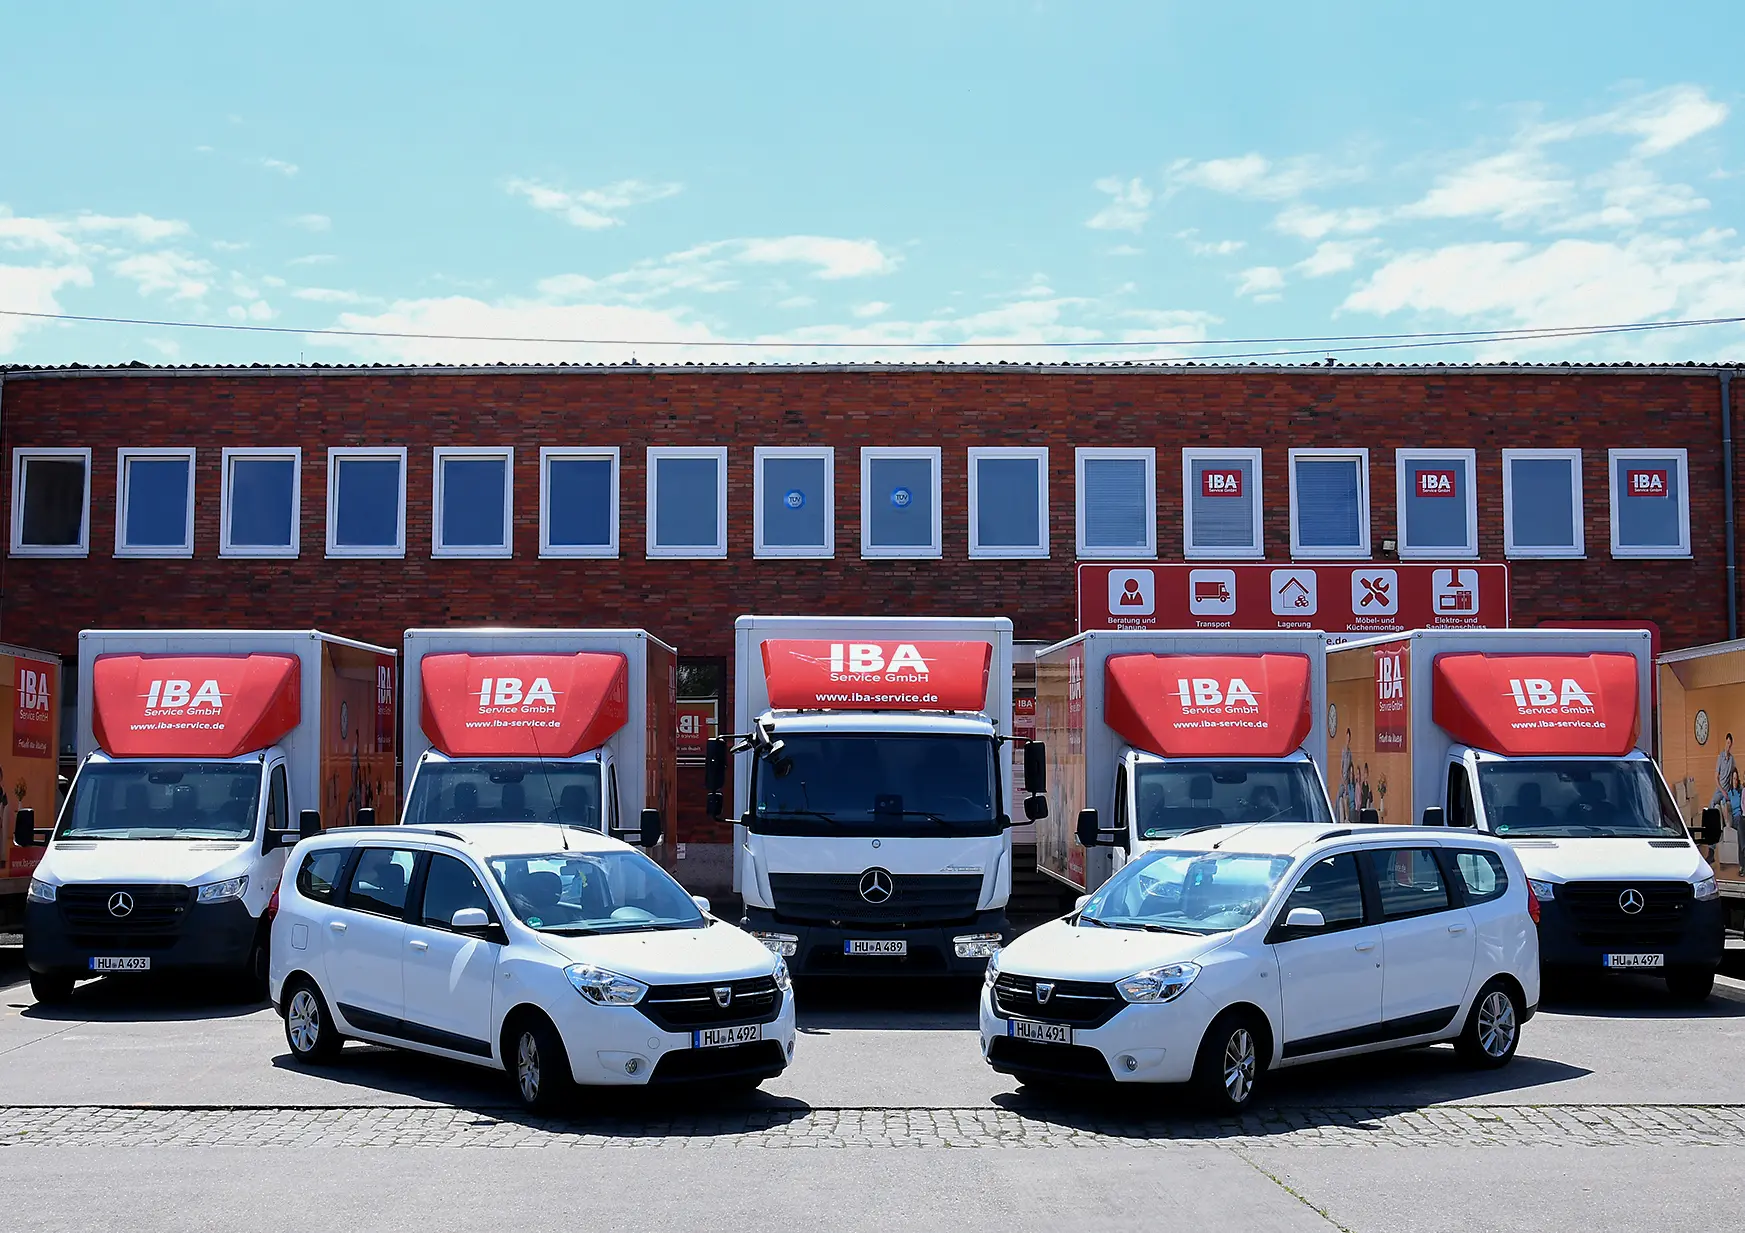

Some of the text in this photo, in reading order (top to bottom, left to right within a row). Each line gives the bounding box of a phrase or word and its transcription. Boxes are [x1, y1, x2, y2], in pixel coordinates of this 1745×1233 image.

[1208, 474, 1237, 489] IBA
[1422, 474, 1450, 489] IBA
[1633, 474, 1662, 488] IBA
[1107, 617, 1141, 625] Beratung
[1195, 620, 1230, 628] Transport
[1346, 624, 1404, 632] Küchenmontage
[830, 644, 930, 673] IBA
[830, 673, 929, 682] Service GmbH
[1380, 655, 1403, 699] IBA
[20, 669, 49, 711] IBA
[146, 680, 223, 708] IBA
[480, 678, 557, 705] IBA
[1178, 679, 1259, 706] IBA
[1509, 679, 1594, 706] IBA
[815, 693, 938, 702] www.iba-service.de
[1018, 700, 1033, 708] IBA
[144, 708, 184, 716] Service
[478, 706, 518, 714] Service
[1182, 706, 1259, 715] Service GmbH
[1518, 706, 1595, 715] Service GmbH
[130, 722, 225, 730] www.iba-service.de
[465, 720, 561, 728] www.iba-service.de
[1173, 720, 1268, 728] www.iba-service.de
[1511, 720, 1606, 728] www.iba-service.de
[855, 942, 903, 952] HU A 489
[98, 959, 146, 968] HU A 493
[1612, 955, 1660, 965] HU A 497
[704, 1026, 757, 1045] HU A 492
[1016, 1022, 1066, 1041] HU A 491
